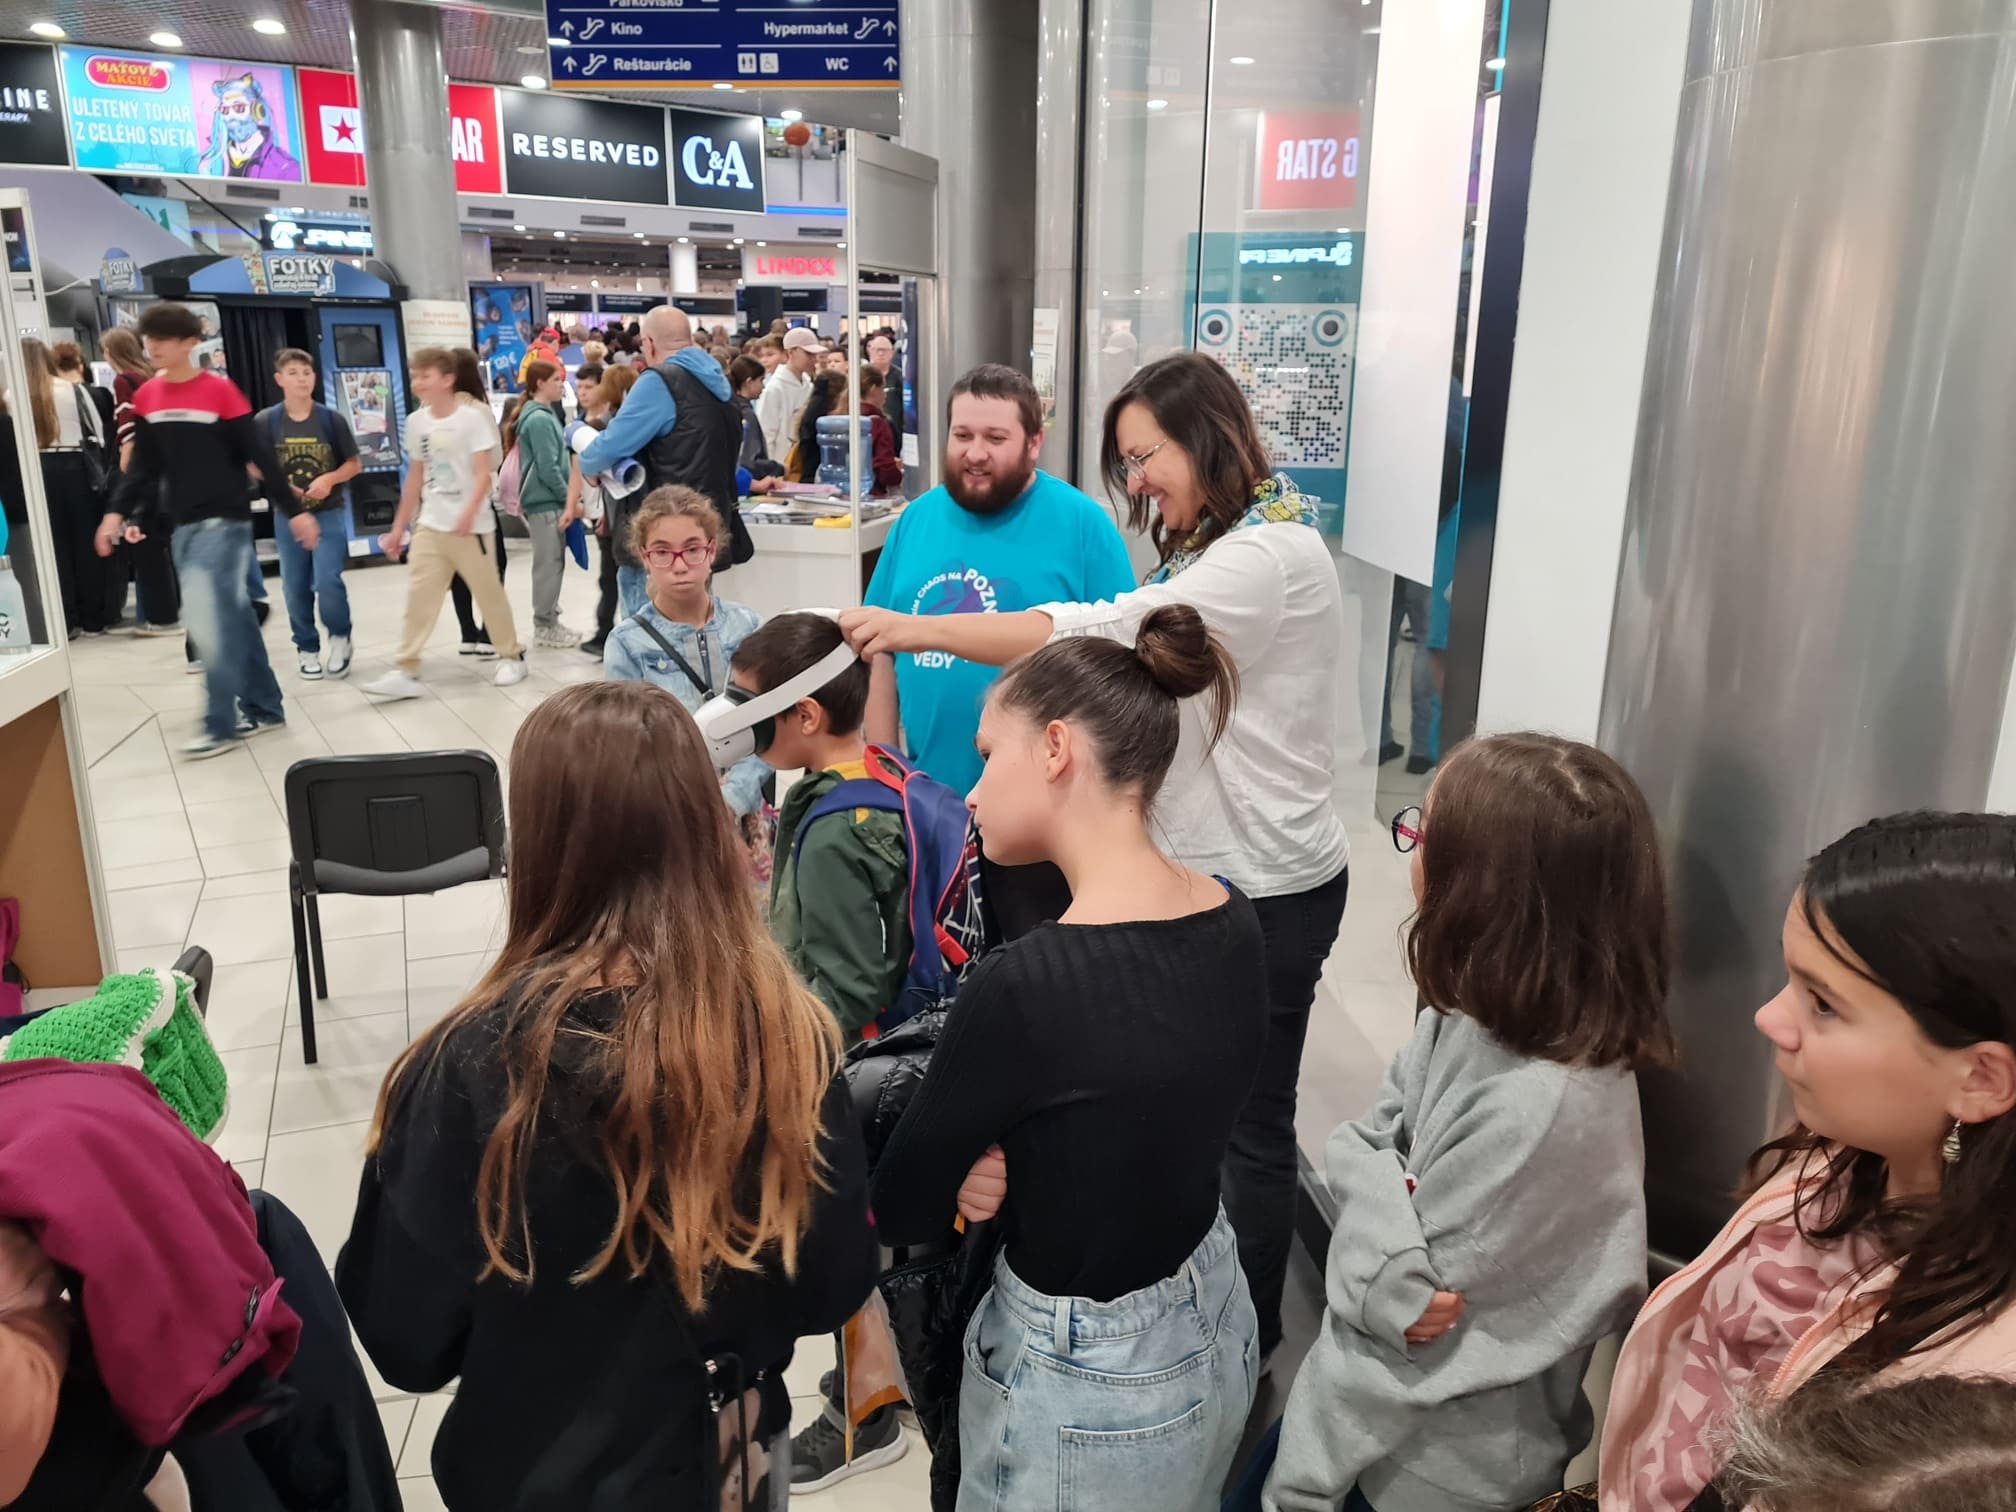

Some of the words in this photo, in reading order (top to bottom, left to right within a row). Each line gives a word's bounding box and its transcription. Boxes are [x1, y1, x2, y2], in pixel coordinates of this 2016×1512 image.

[611, 22, 643, 36] Kino
[764, 21, 849, 37] Hypermarket
[613, 57, 692, 71] Reštaurácie
[825, 58, 849, 71] WC
[106, 73, 153, 87] AKCIE
[72, 95, 140, 120] ULETENÝ
[144, 102, 193, 123] TOVAR
[75, 121, 86, 141] Z
[88, 119, 146, 144] CELÉHO
[151, 127, 196, 147] SVETA
[452, 116, 484, 163] AR
[512, 132, 660, 168] RESERVED
[682, 136, 755, 190] C&A
[270, 258, 332, 274] FOTKY
[917, 573, 946, 599] CHAOS
[947, 572, 962, 581] NA
[963, 568, 998, 613] POZN
[913, 651, 956, 669] VEDY
